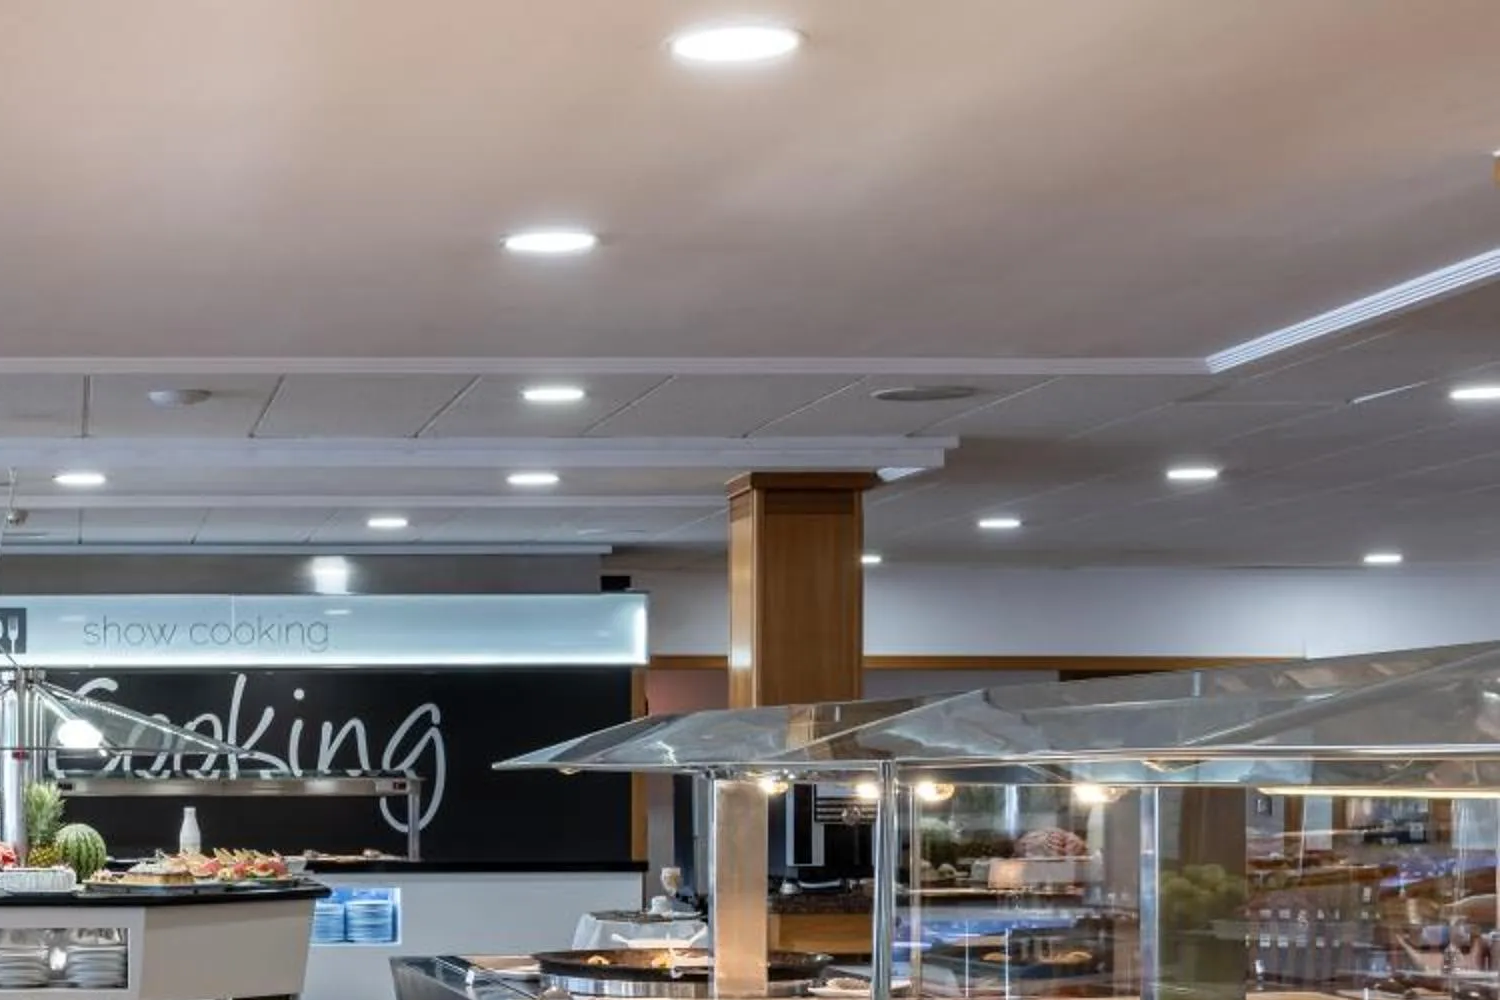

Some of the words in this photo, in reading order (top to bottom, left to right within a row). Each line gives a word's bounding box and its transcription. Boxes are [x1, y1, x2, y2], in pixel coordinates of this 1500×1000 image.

[82, 614, 179, 647] show
[188, 614, 330, 653] cooking
[47, 673, 447, 833] Cooking
